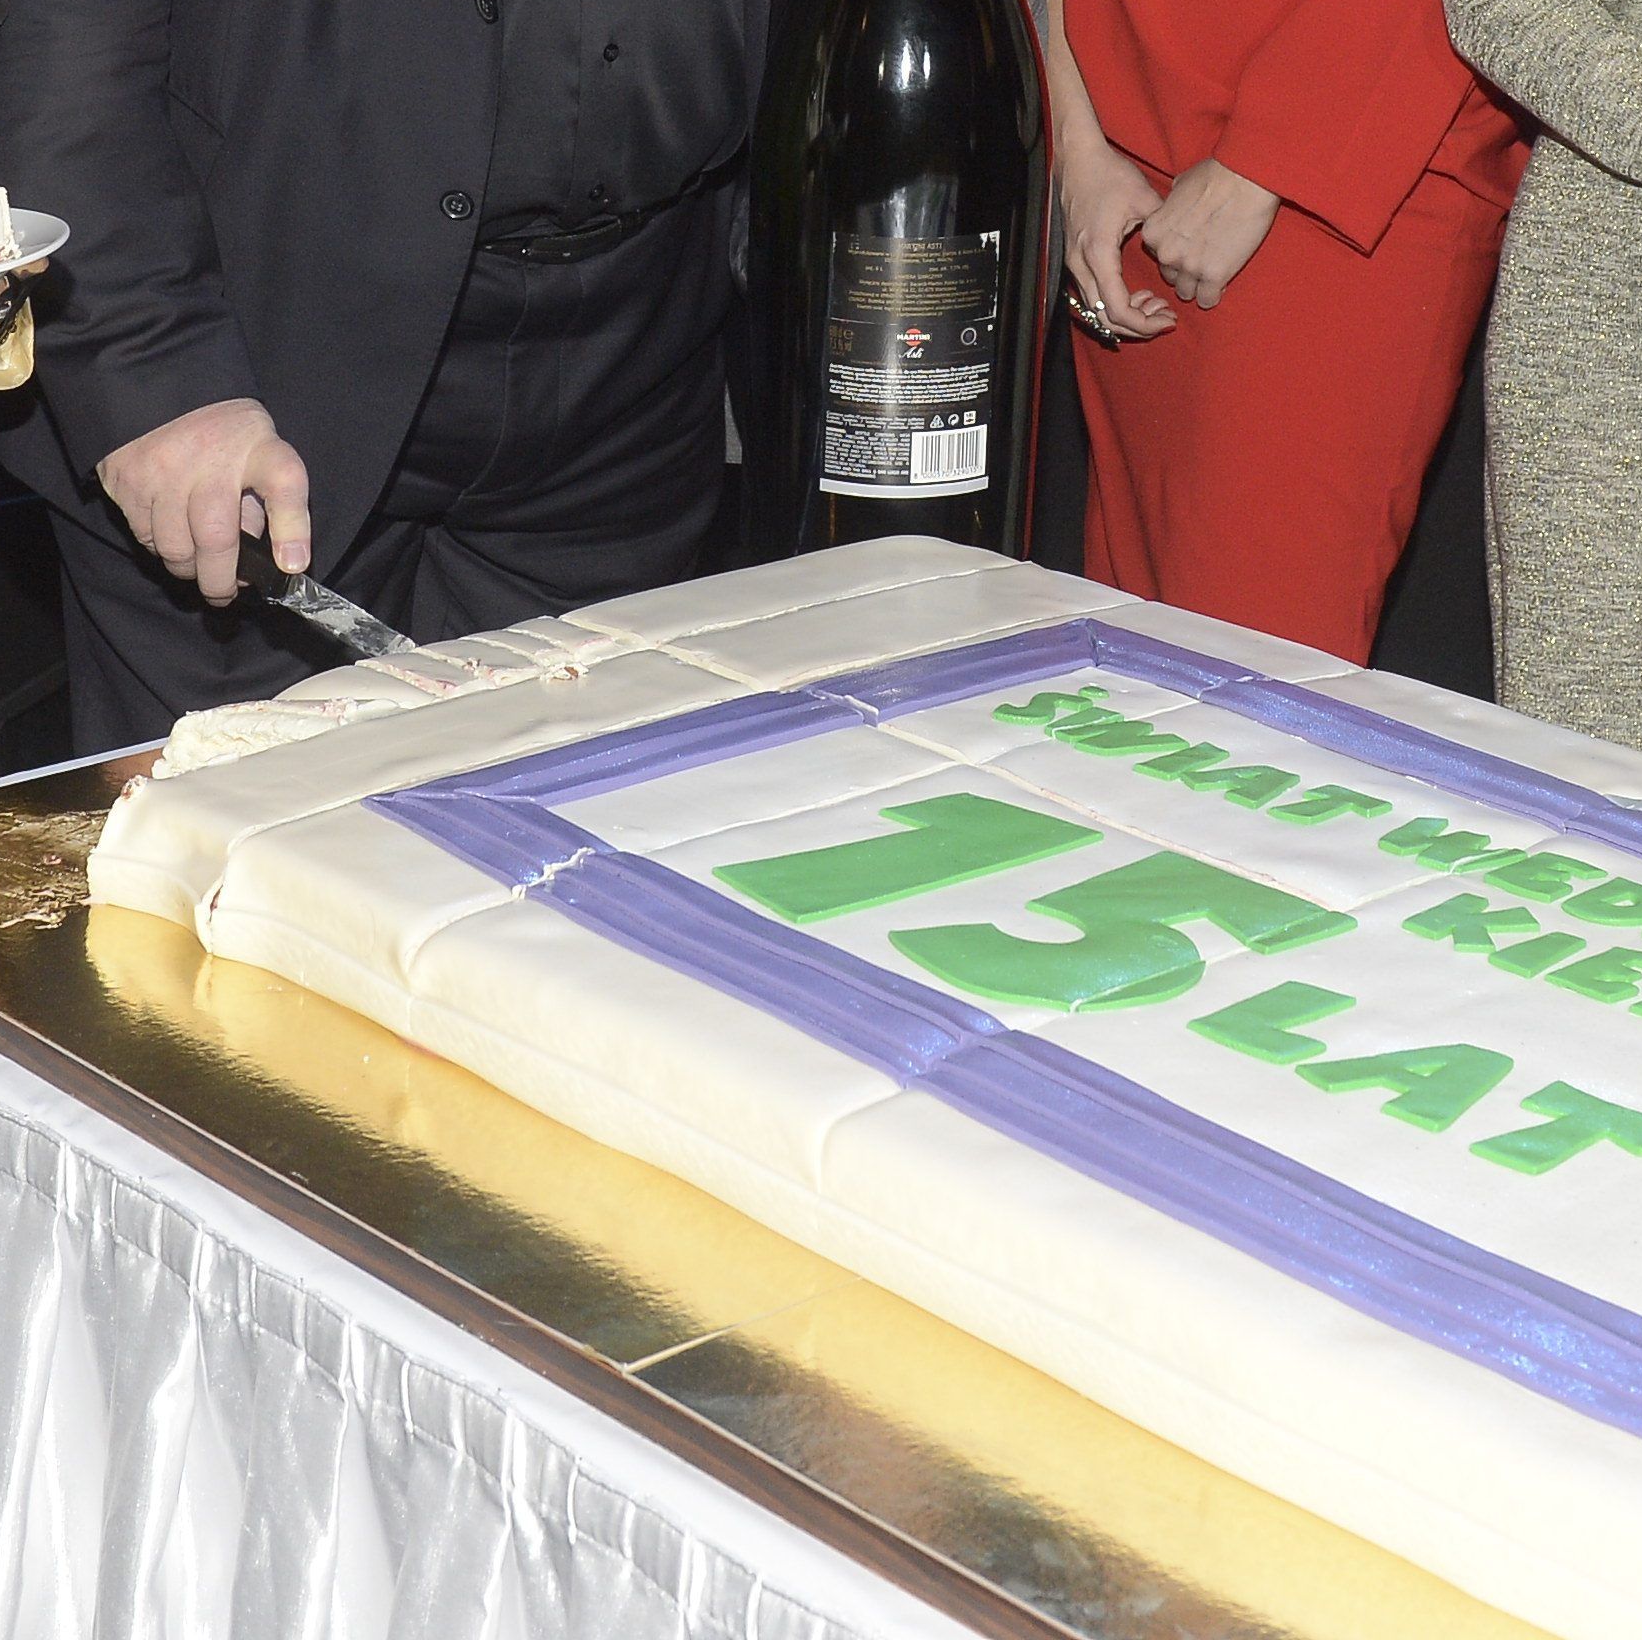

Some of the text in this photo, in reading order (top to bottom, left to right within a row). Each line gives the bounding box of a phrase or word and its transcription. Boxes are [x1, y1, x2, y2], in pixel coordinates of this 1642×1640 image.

[896, 333, 931, 341] MARTINI
[992, 685, 1392, 825] ŚWIAT
[713, 792, 1358, 1013] 15
